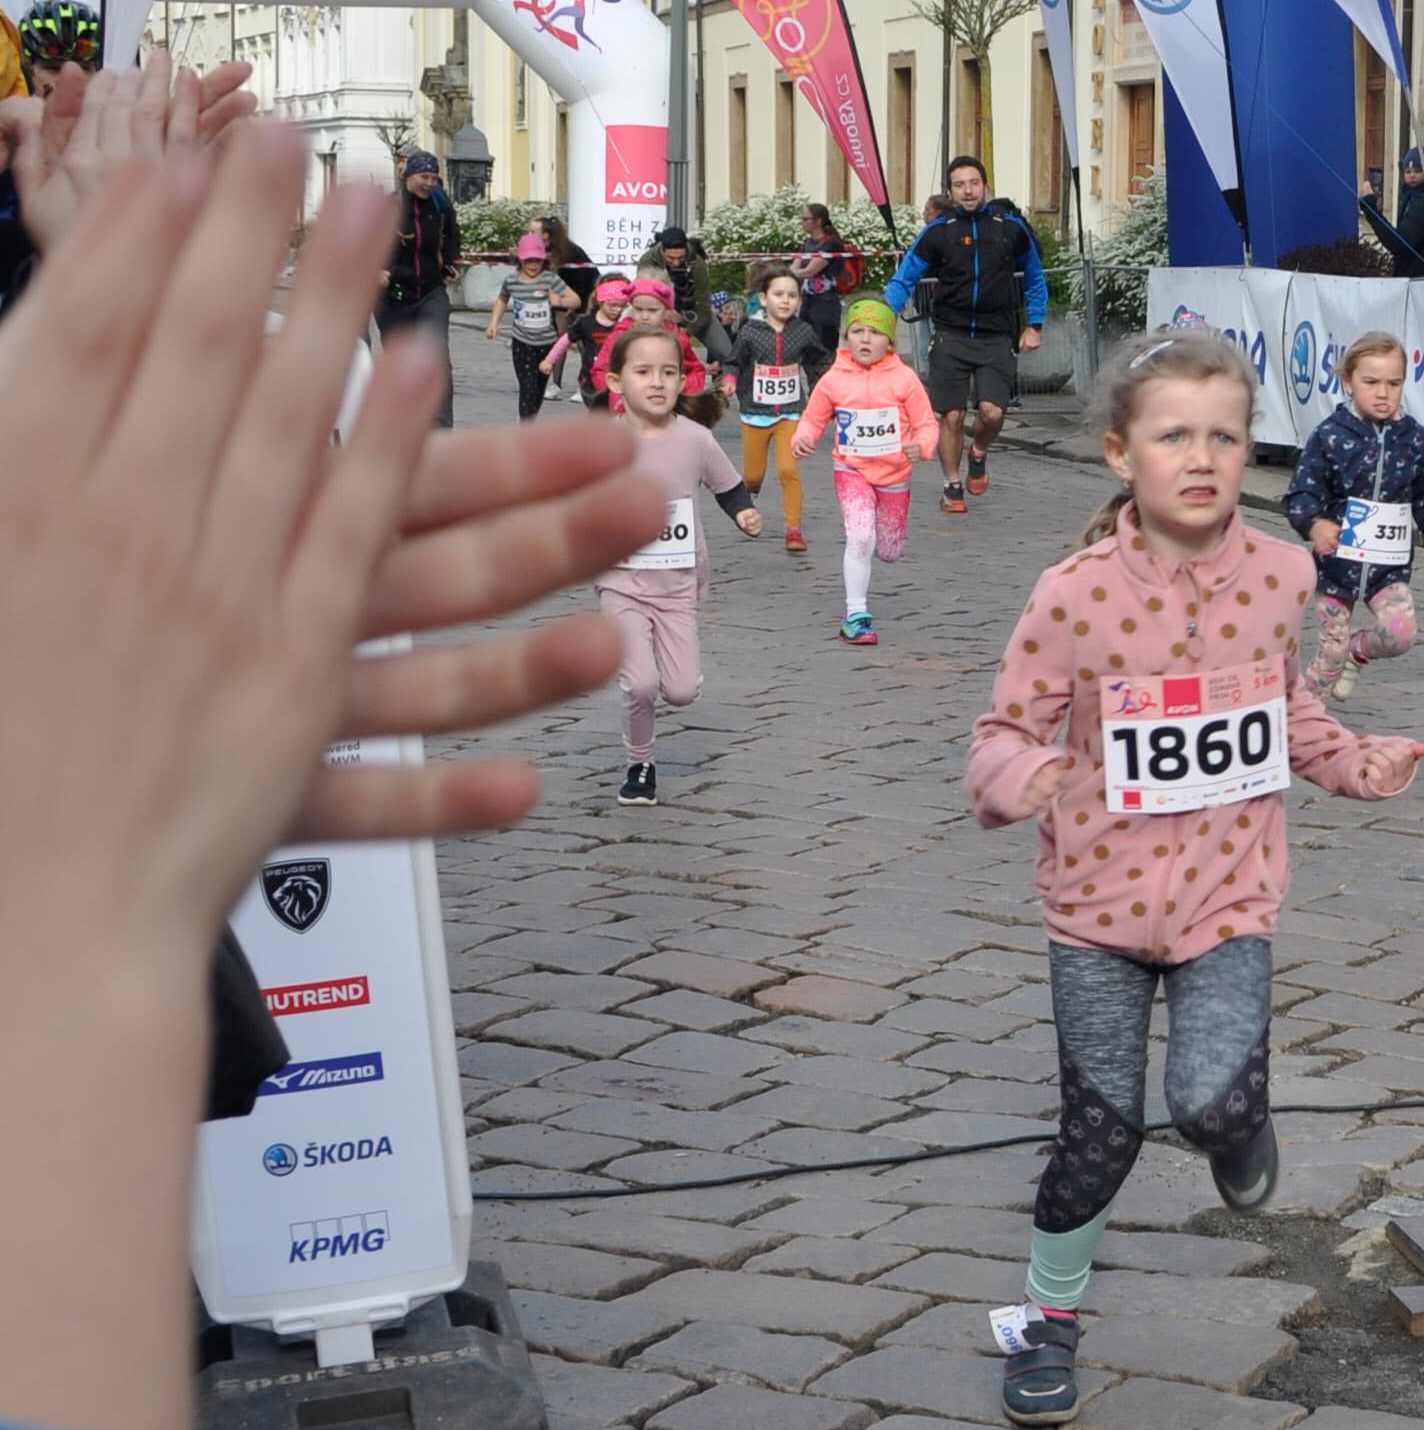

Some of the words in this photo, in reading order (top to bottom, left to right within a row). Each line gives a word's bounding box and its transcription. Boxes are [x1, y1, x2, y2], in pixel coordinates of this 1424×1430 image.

[606, 217, 642, 233] BĚH
[756, 378, 797, 396] 1859
[855, 422, 897, 438] 3364
[1374, 524, 1407, 541] 3311
[1111, 710, 1271, 782] 1860
[303, 1135, 394, 1169] ŠKODA
[289, 1227, 386, 1264] KPMG
